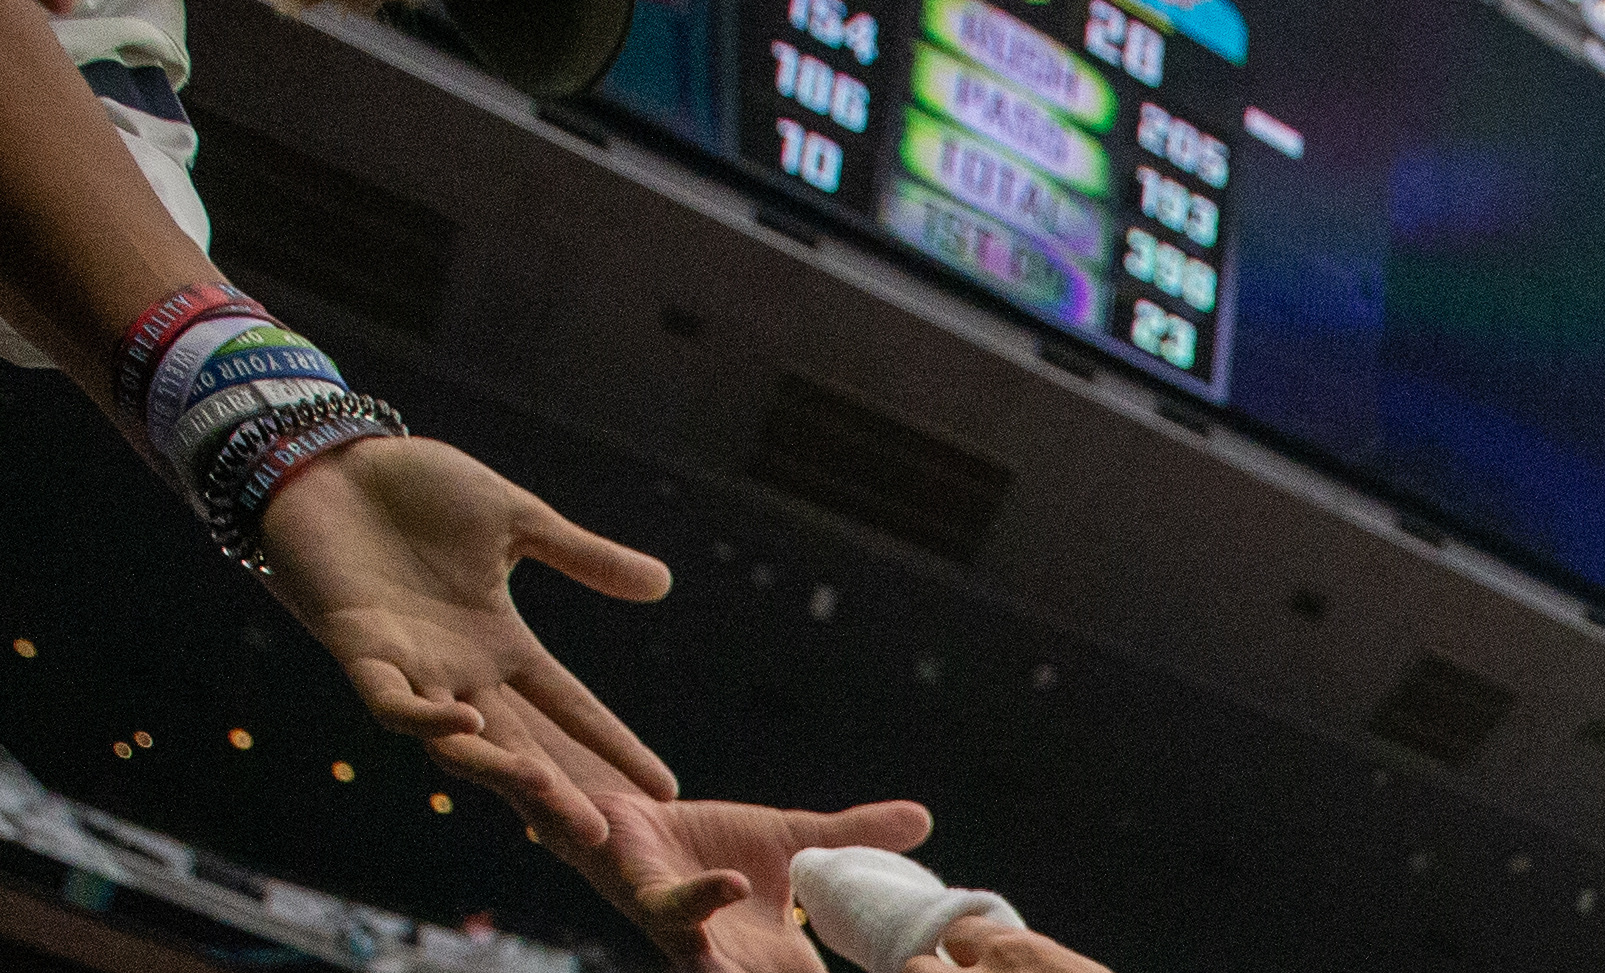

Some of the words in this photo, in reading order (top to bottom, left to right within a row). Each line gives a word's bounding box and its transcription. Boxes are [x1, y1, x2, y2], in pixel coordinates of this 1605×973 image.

[955, 72, 1072, 163] PASS
[1137, 101, 1230, 190] 205
[776, 117, 844, 194] 10
[1131, 298, 1198, 370] 23
[128, 293, 193, 363] REALITY
[221, 353, 281, 381] YOUR
[274, 424, 342, 467] DREAM
